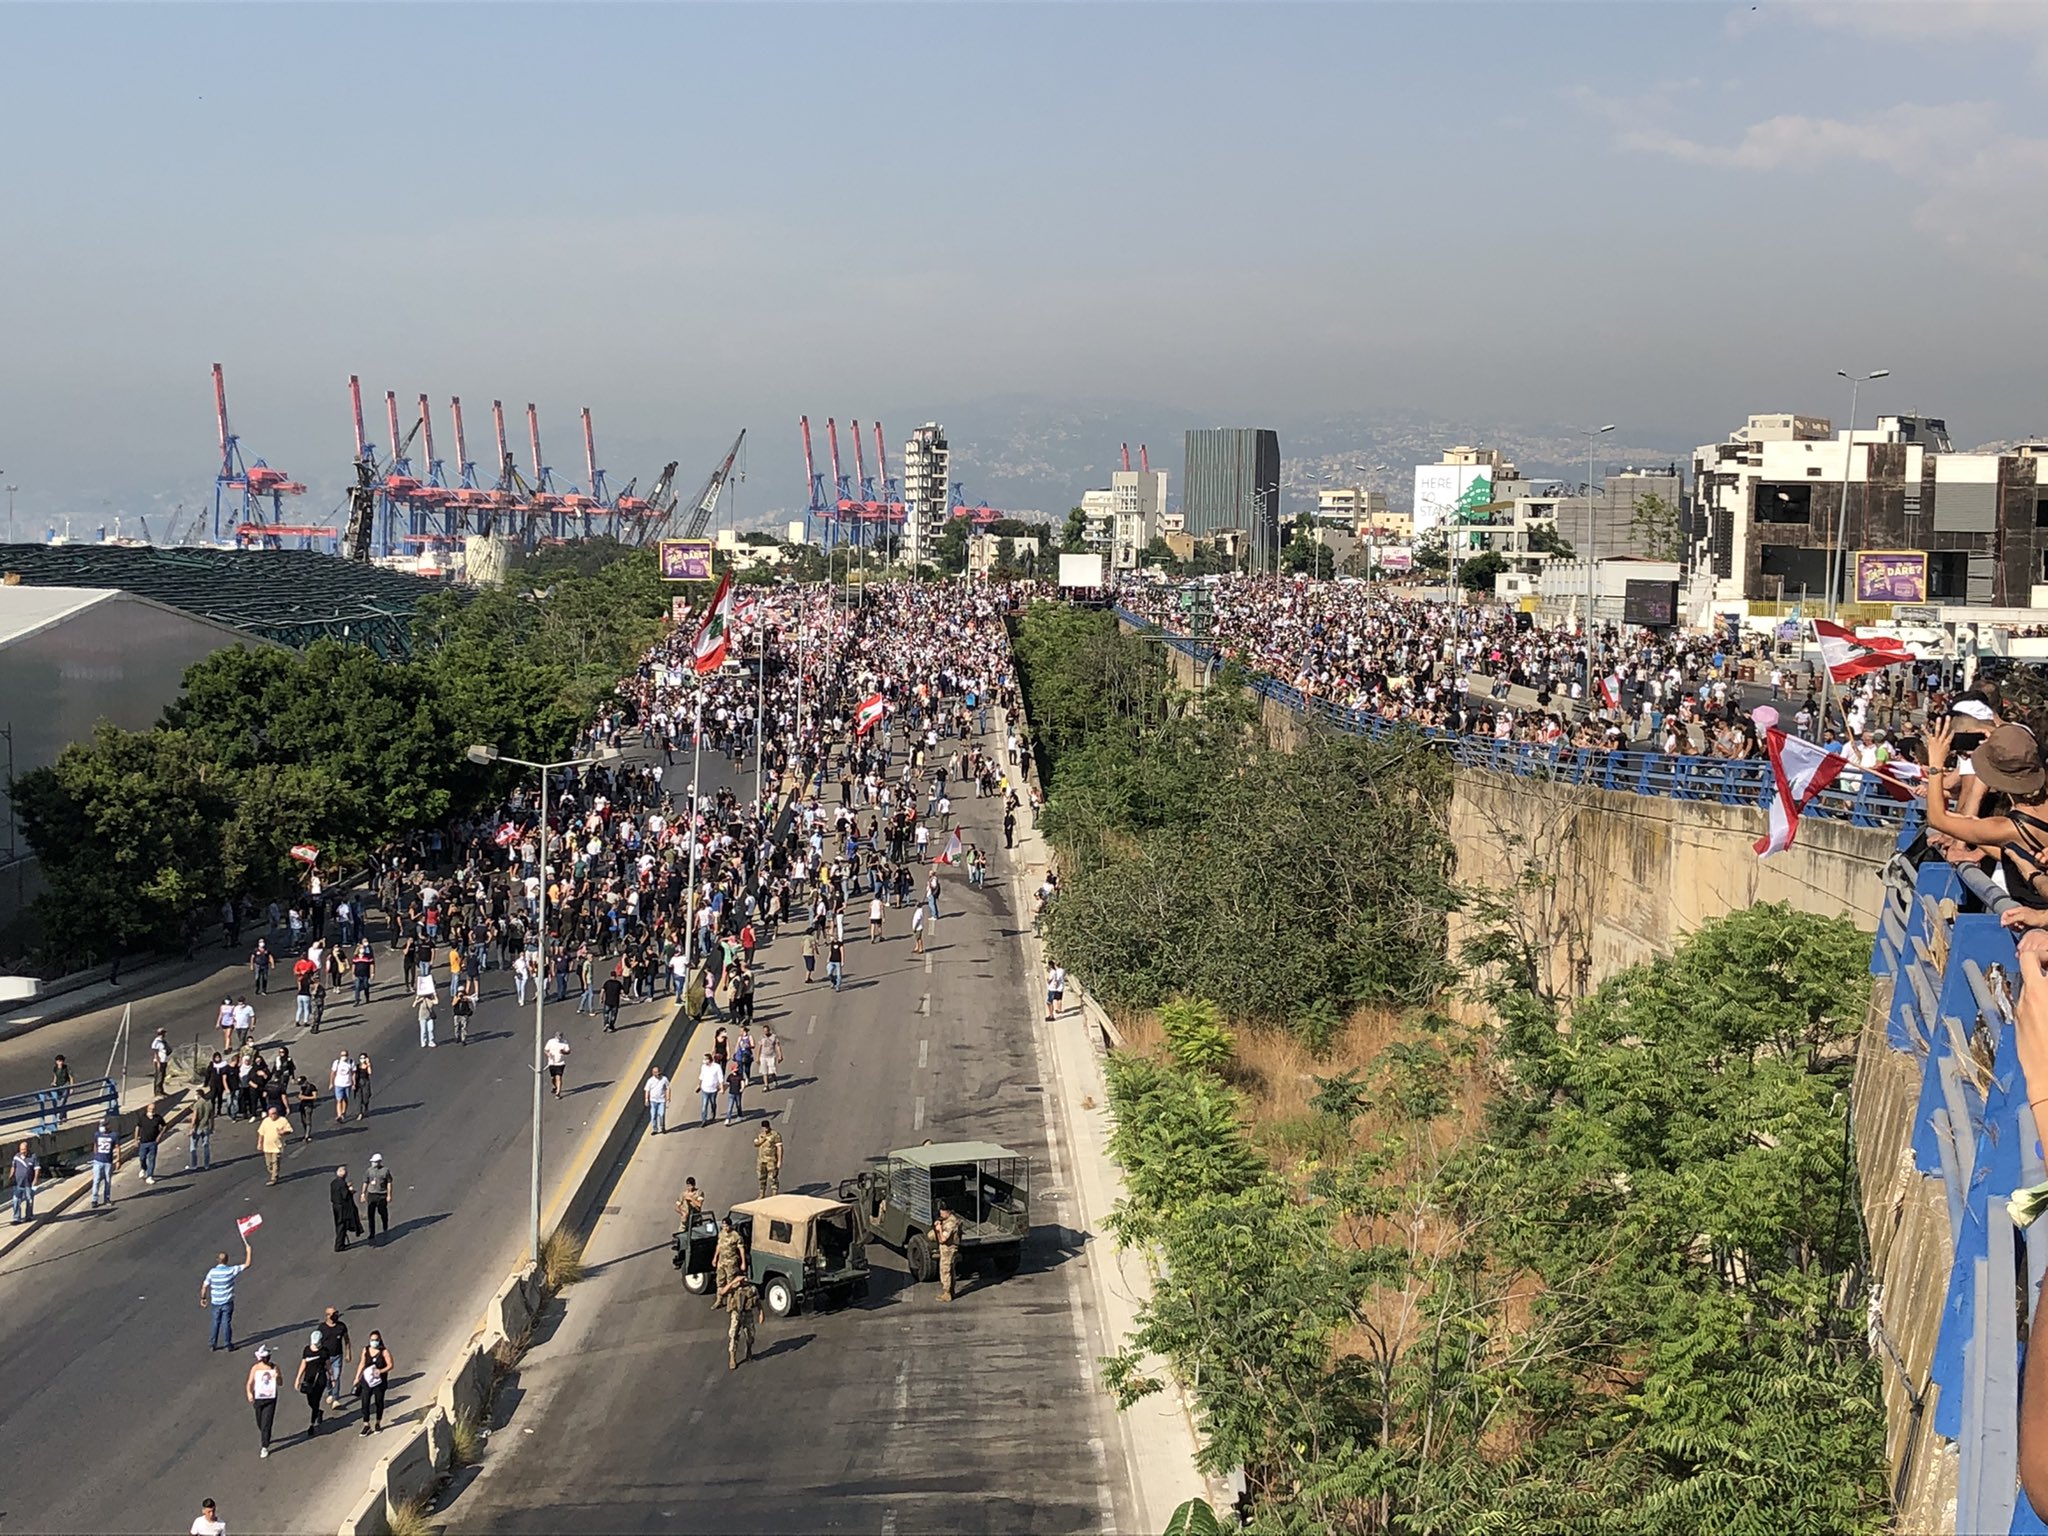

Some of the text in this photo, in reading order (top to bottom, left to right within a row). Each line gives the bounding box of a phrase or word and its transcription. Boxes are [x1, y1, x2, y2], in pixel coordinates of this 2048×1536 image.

[1421, 477, 1452, 489] HERE
[1421, 491, 1436, 503] TO
[1420, 505, 1445, 517] STA
[1887, 565, 1922, 577] DARE?
